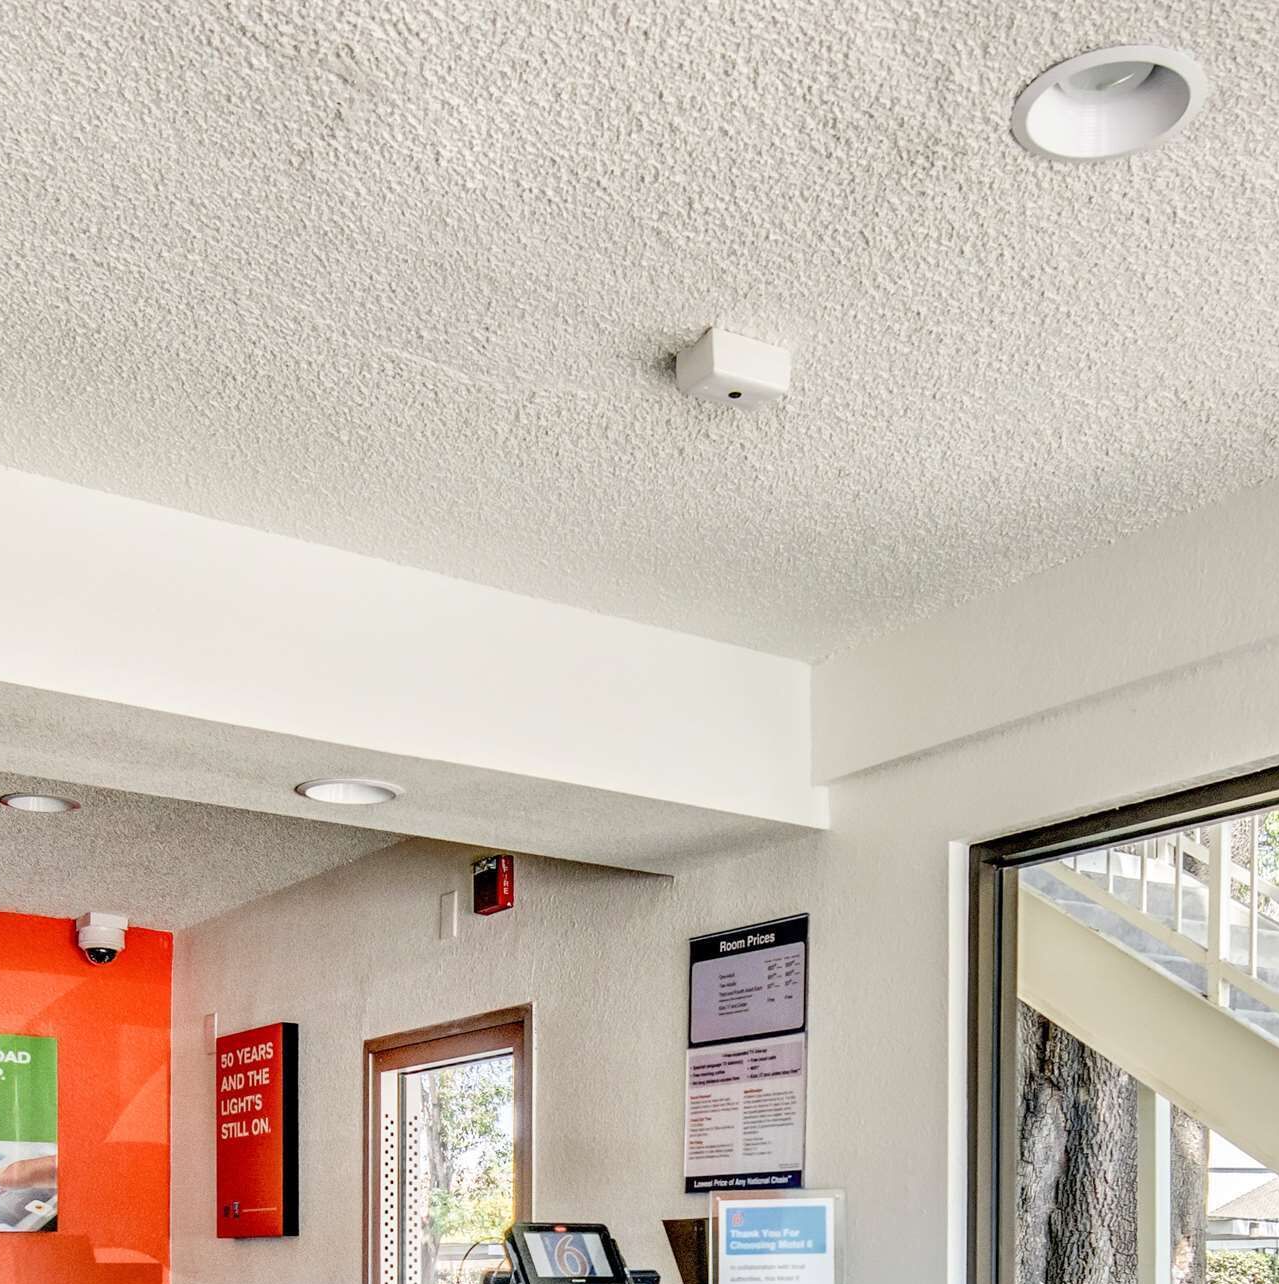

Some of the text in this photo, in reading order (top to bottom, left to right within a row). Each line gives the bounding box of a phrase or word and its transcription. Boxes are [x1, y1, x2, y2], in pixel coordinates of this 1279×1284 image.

[720, 933, 776, 953] Room Prices
[221, 1042, 273, 1068] 50 YEARS
[221, 1067, 270, 1092] AND THE
[221, 1117, 271, 1139] STILL ON.
[714, 1177, 728, 1186] Price
[735, 1177, 746, 1187] Any
[730, 1228, 800, 1238] Thank You For
[730, 1240, 776, 1251] Choosing
[554, 1235, 590, 1278] 6
